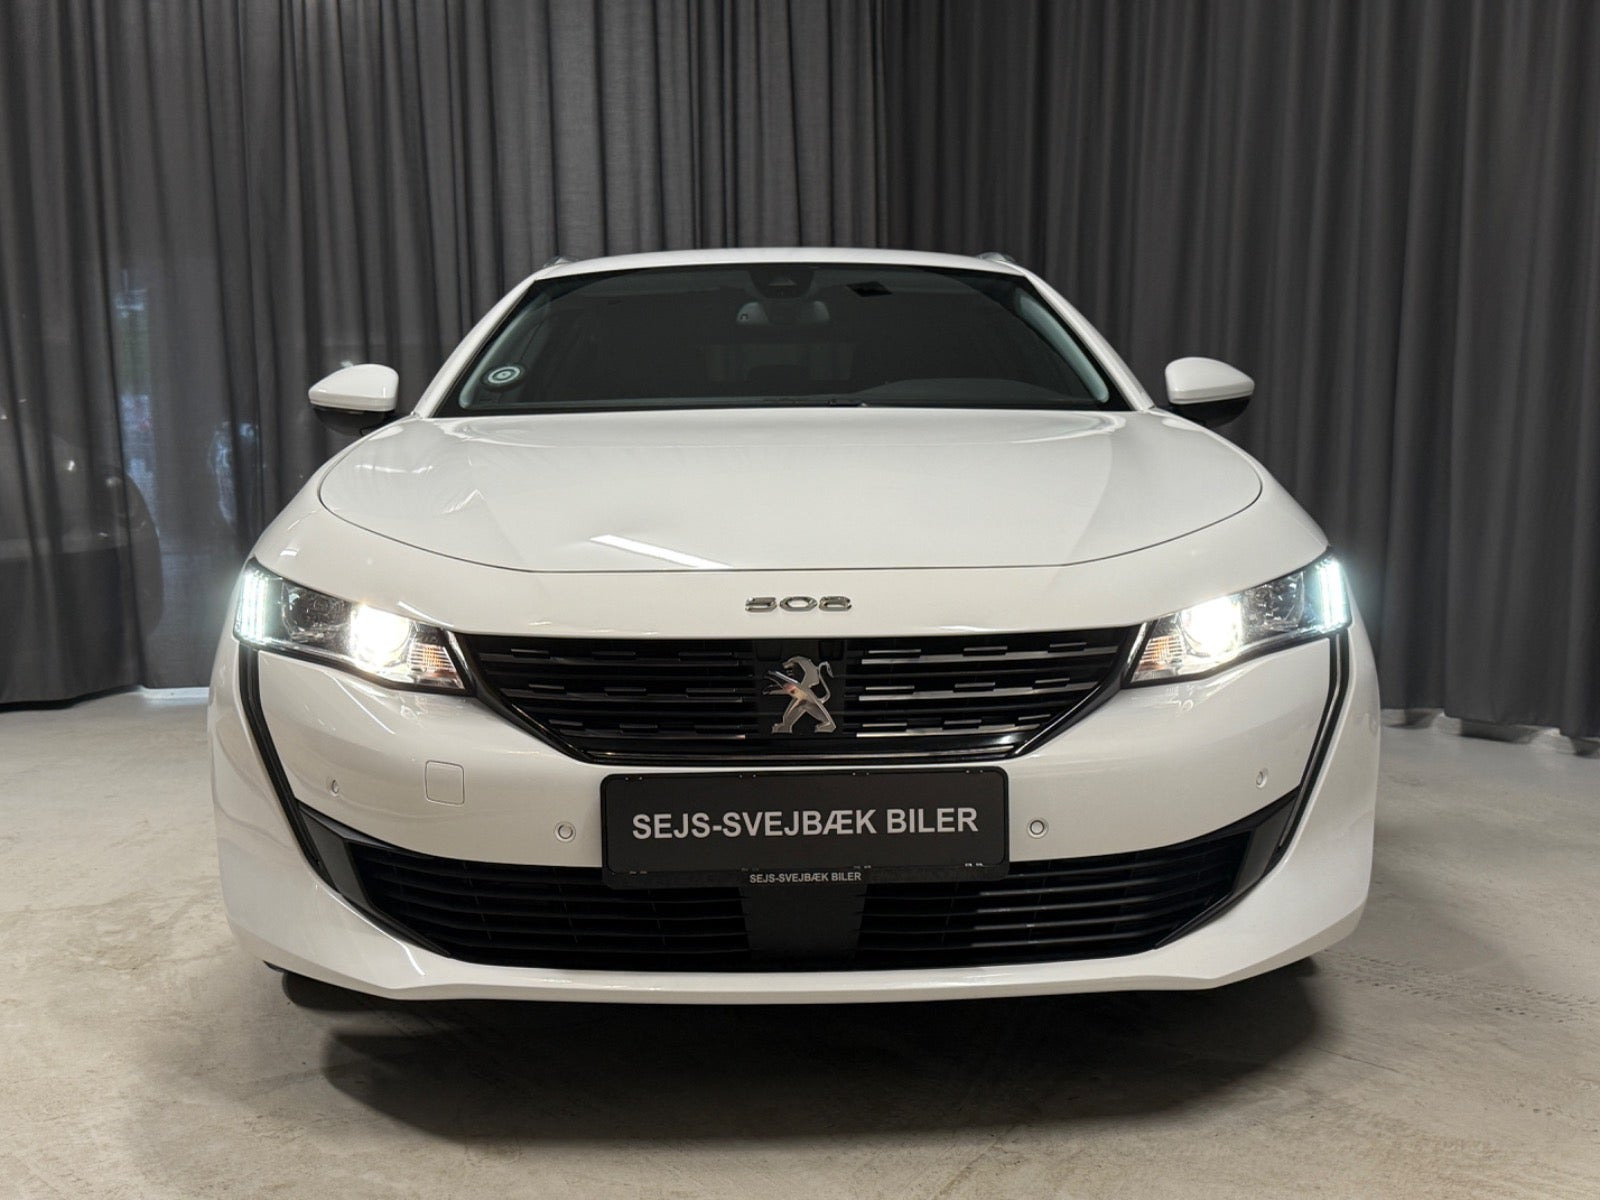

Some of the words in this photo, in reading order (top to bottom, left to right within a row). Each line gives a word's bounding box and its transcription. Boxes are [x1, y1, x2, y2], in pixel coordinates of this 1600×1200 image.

[745, 596, 852, 613] 508
[632, 809, 877, 839] SEJS-SVEJBÆK
[886, 807, 979, 834] BILER
[750, 873, 829, 883] SEJS-SVEJBÆK
[831, 872, 862, 882] BILER
